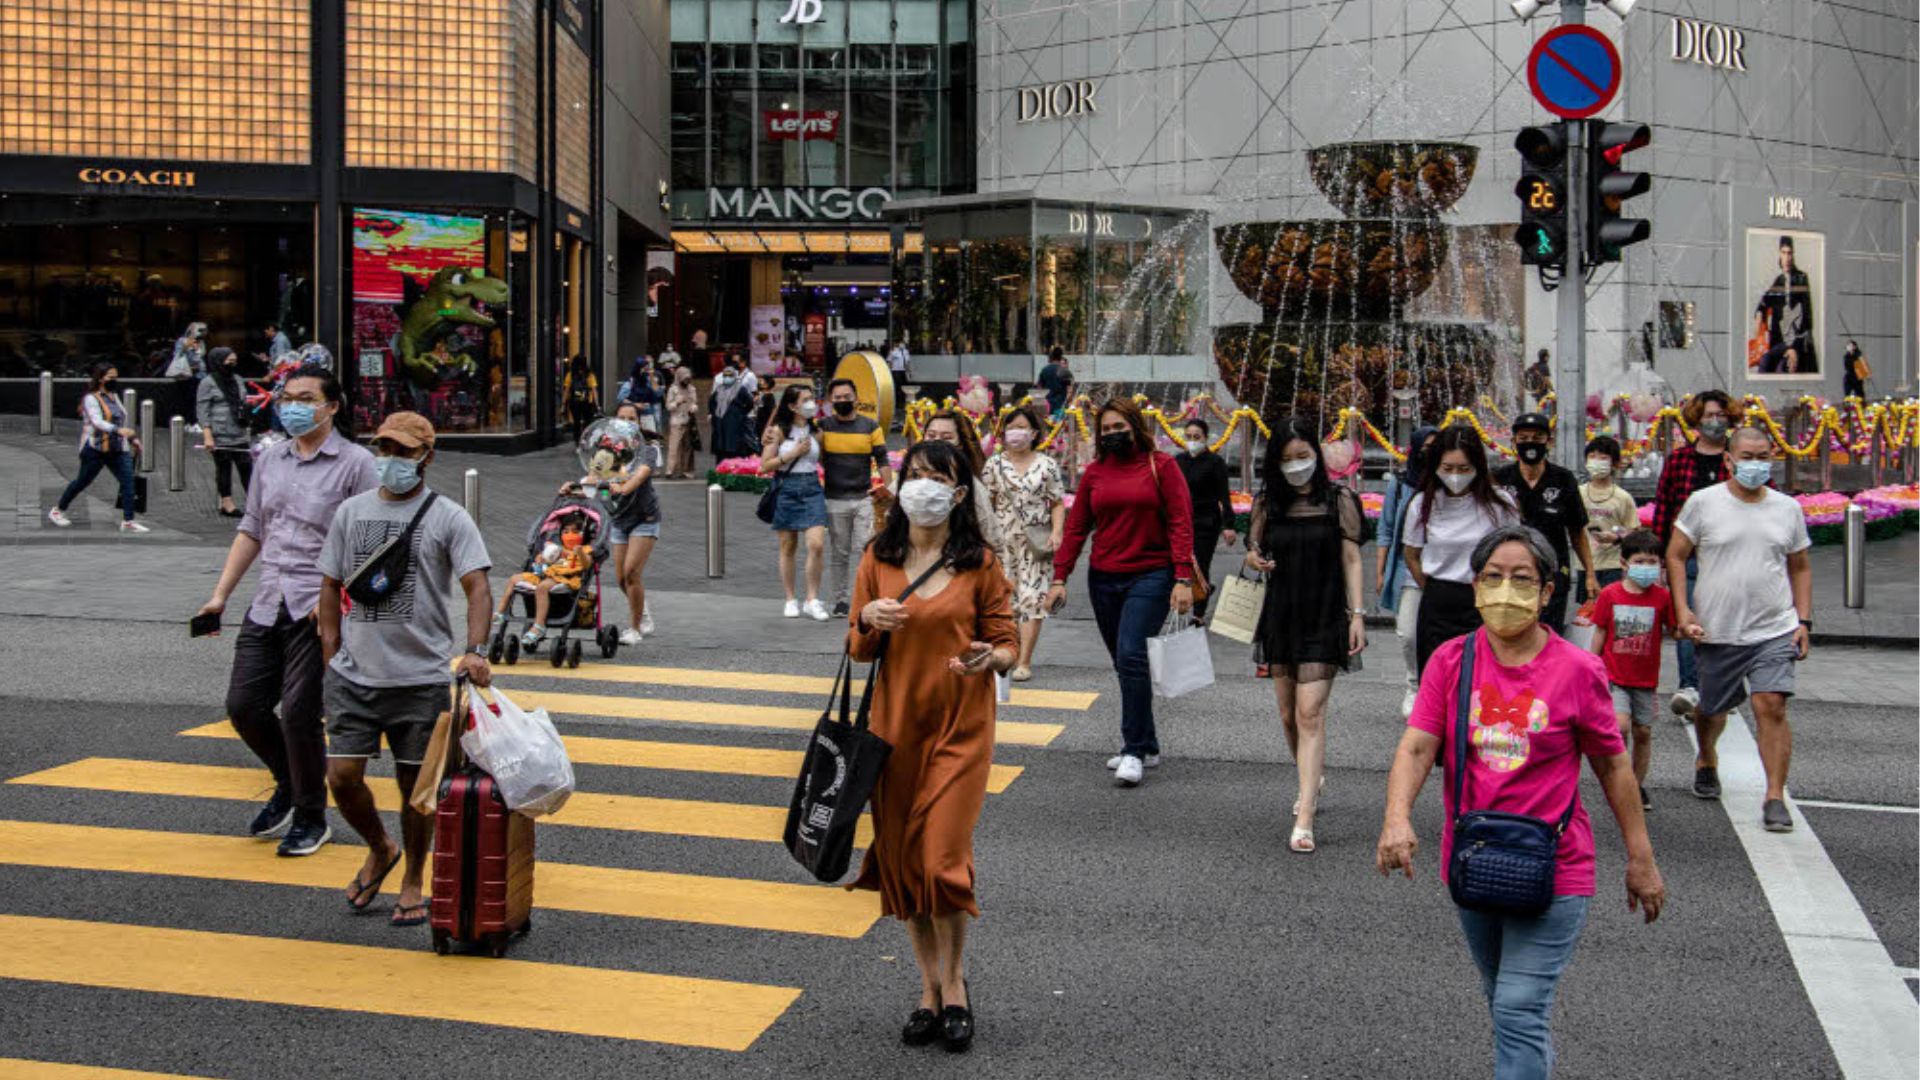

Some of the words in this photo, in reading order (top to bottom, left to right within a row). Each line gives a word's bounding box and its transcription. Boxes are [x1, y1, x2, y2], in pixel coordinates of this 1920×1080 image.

[1670, 17, 1748, 72] DIOR
[1016, 80, 1097, 123] DIOR
[78, 167, 196, 187] COACH
[709, 186, 893, 220] MANGO
[1768, 195, 1805, 221] DIOR
